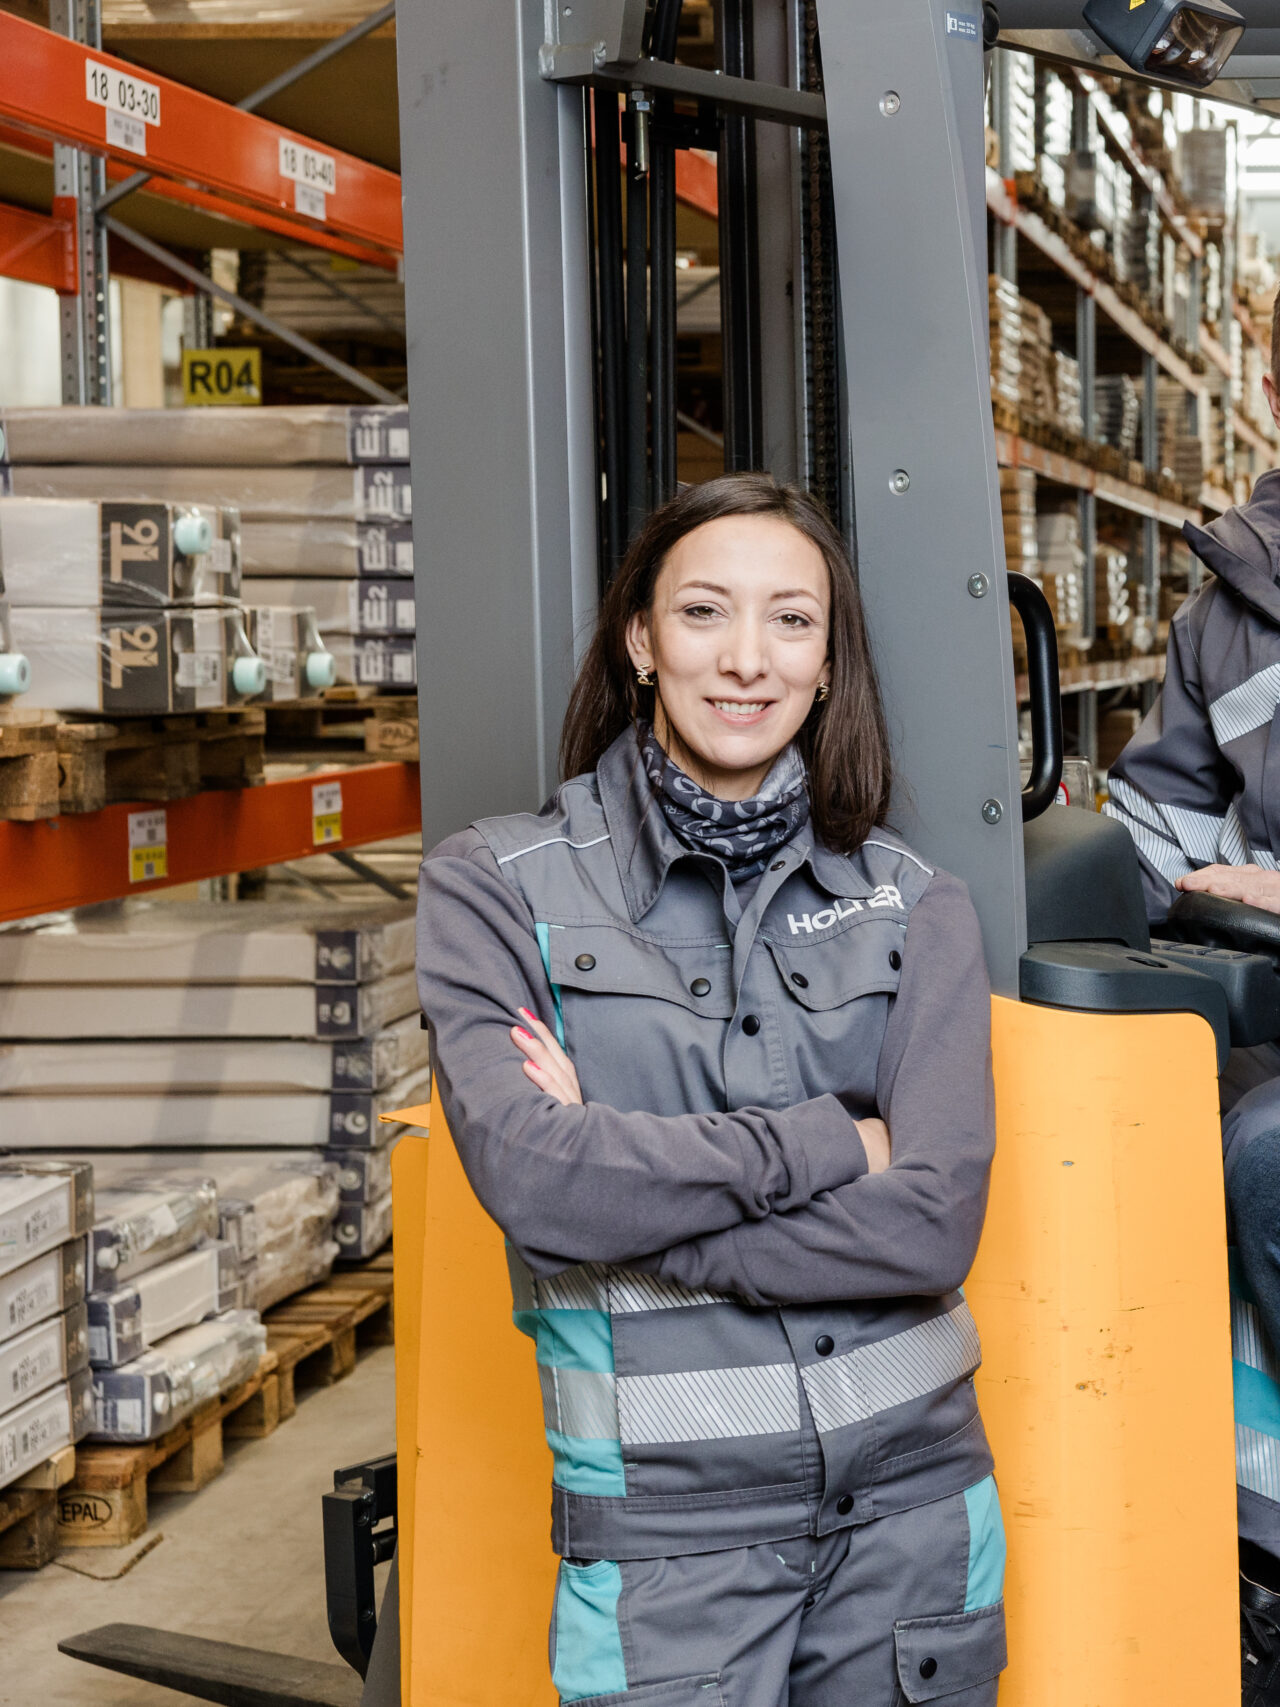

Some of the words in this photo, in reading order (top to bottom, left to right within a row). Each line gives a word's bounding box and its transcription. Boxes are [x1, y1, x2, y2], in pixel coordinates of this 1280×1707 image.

[91, 68, 109, 101] 18
[118, 79, 158, 120] 03-30
[284, 146, 297, 174] 18
[303, 153, 334, 186] 03-40
[189, 360, 255, 395] R04
[368, 471, 394, 514] E2
[362, 528, 387, 571] E2
[363, 585, 388, 629] E2
[360, 639, 384, 682] E2
[786, 884, 905, 935] HOLTER
[61, 1502, 104, 1522] EPAL
